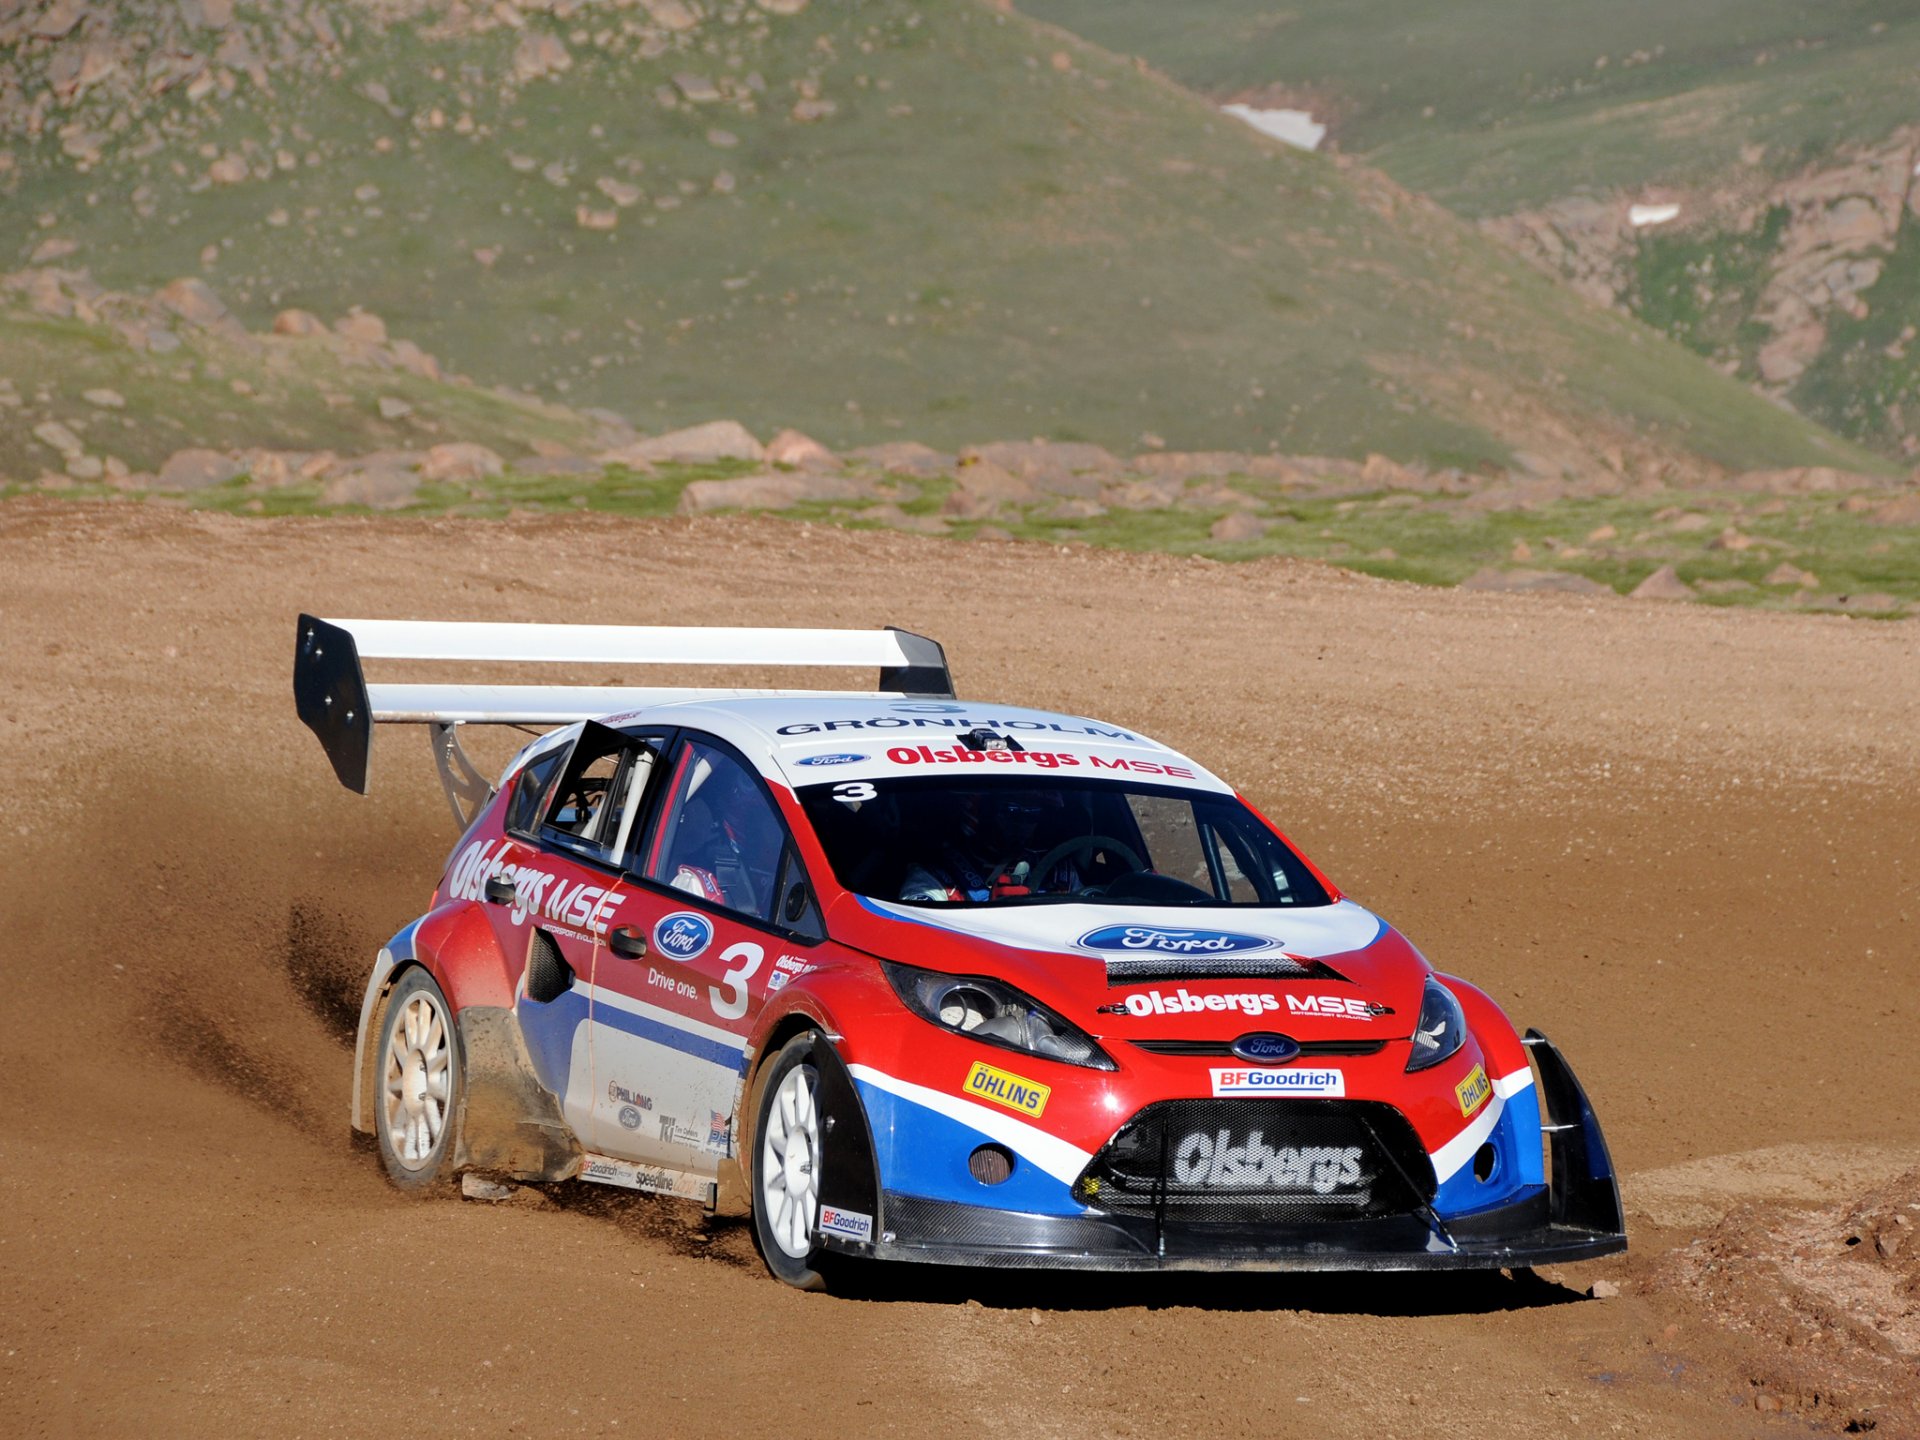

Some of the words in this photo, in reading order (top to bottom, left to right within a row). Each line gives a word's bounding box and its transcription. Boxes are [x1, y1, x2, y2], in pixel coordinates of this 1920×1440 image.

[888, 703, 967, 714] 3
[776, 717, 1135, 741] GRÖNHOLM
[887, 746, 1080, 768] Olsbergs
[1089, 756, 1196, 779] MSE
[832, 782, 878, 802] 3
[545, 879, 627, 934] MSE
[576, 931, 606, 947] EVOLUON
[663, 919, 699, 951] Ford
[1121, 928, 1235, 951] Ford
[648, 967, 675, 991] Drive
[677, 980, 698, 1000] one.
[708, 942, 764, 1020] 3
[1125, 989, 1279, 1016] Olsbergs
[1285, 995, 1370, 1017] MSE
[1291, 1011, 1335, 1019] MOTORSPORT
[1250, 1038, 1286, 1053] Ford
[973, 1067, 1040, 1109] ÖHLINS
[1220, 1072, 1337, 1086] BFGoodrich
[1460, 1072, 1488, 1108] ÖHLINS
[1174, 1129, 1363, 1194] Olsbergs
[823, 1210, 869, 1232] BFGoodrich
